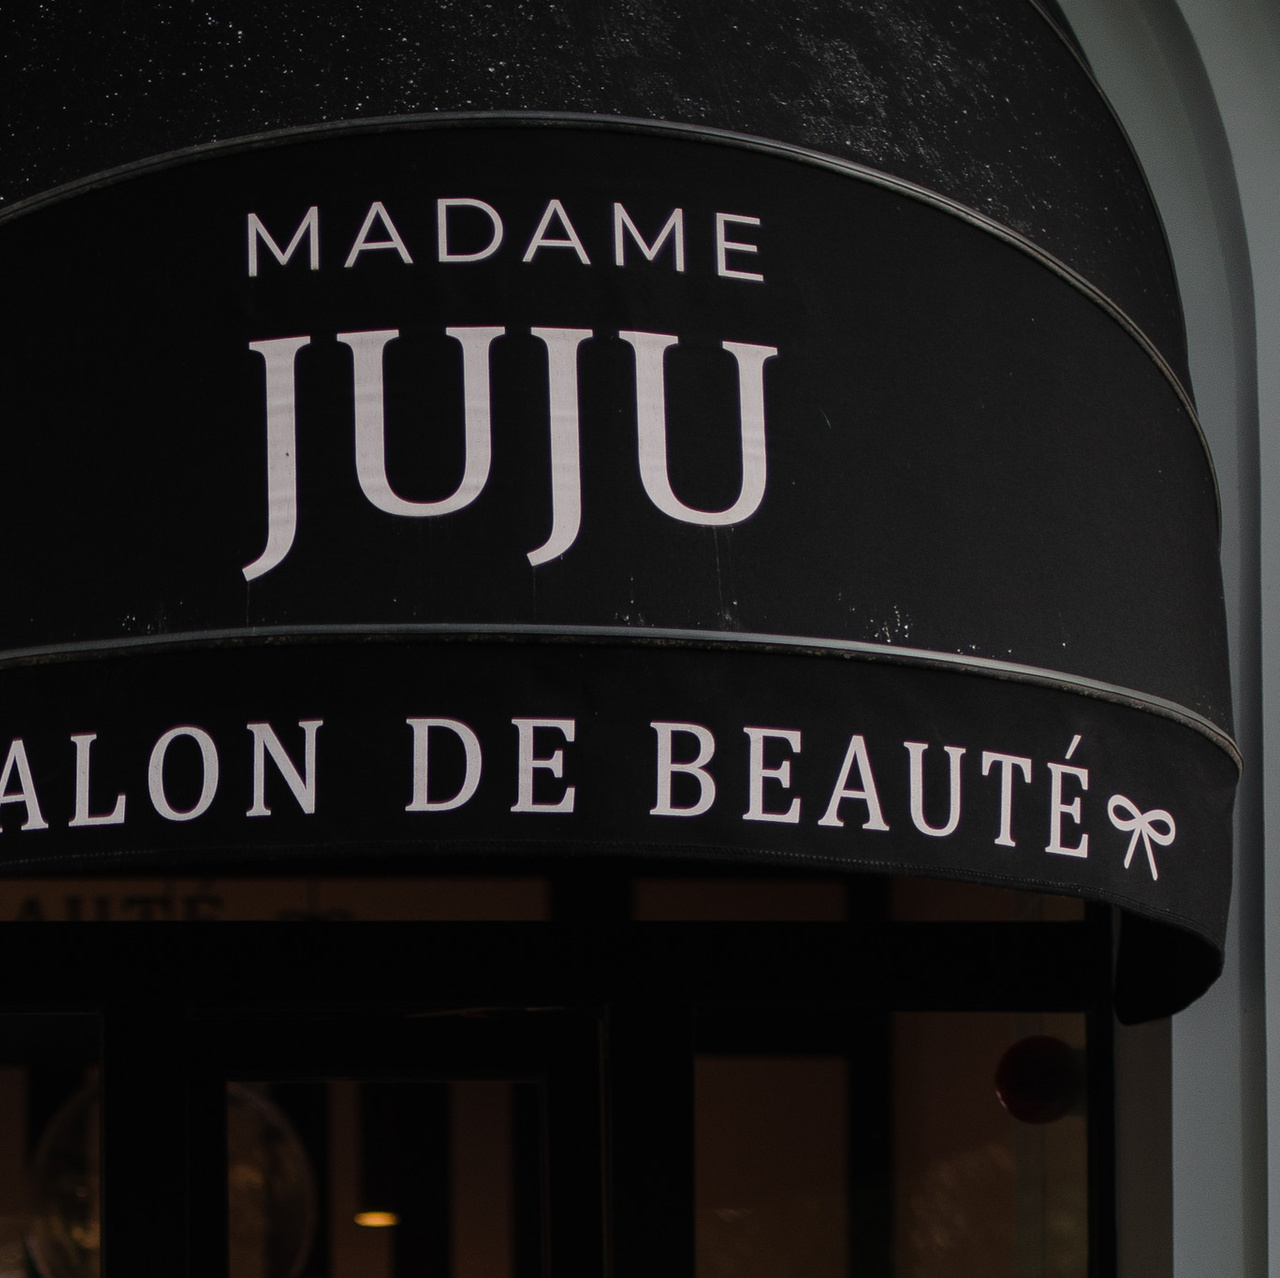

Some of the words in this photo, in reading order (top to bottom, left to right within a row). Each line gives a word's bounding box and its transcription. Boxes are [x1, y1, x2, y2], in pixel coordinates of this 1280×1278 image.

[246, 196, 766, 283] MADAME
[240, 325, 780, 583] JUJU
[404, 717, 578, 814] DE
[649, 720, 1094, 860] BEAUTÉ
